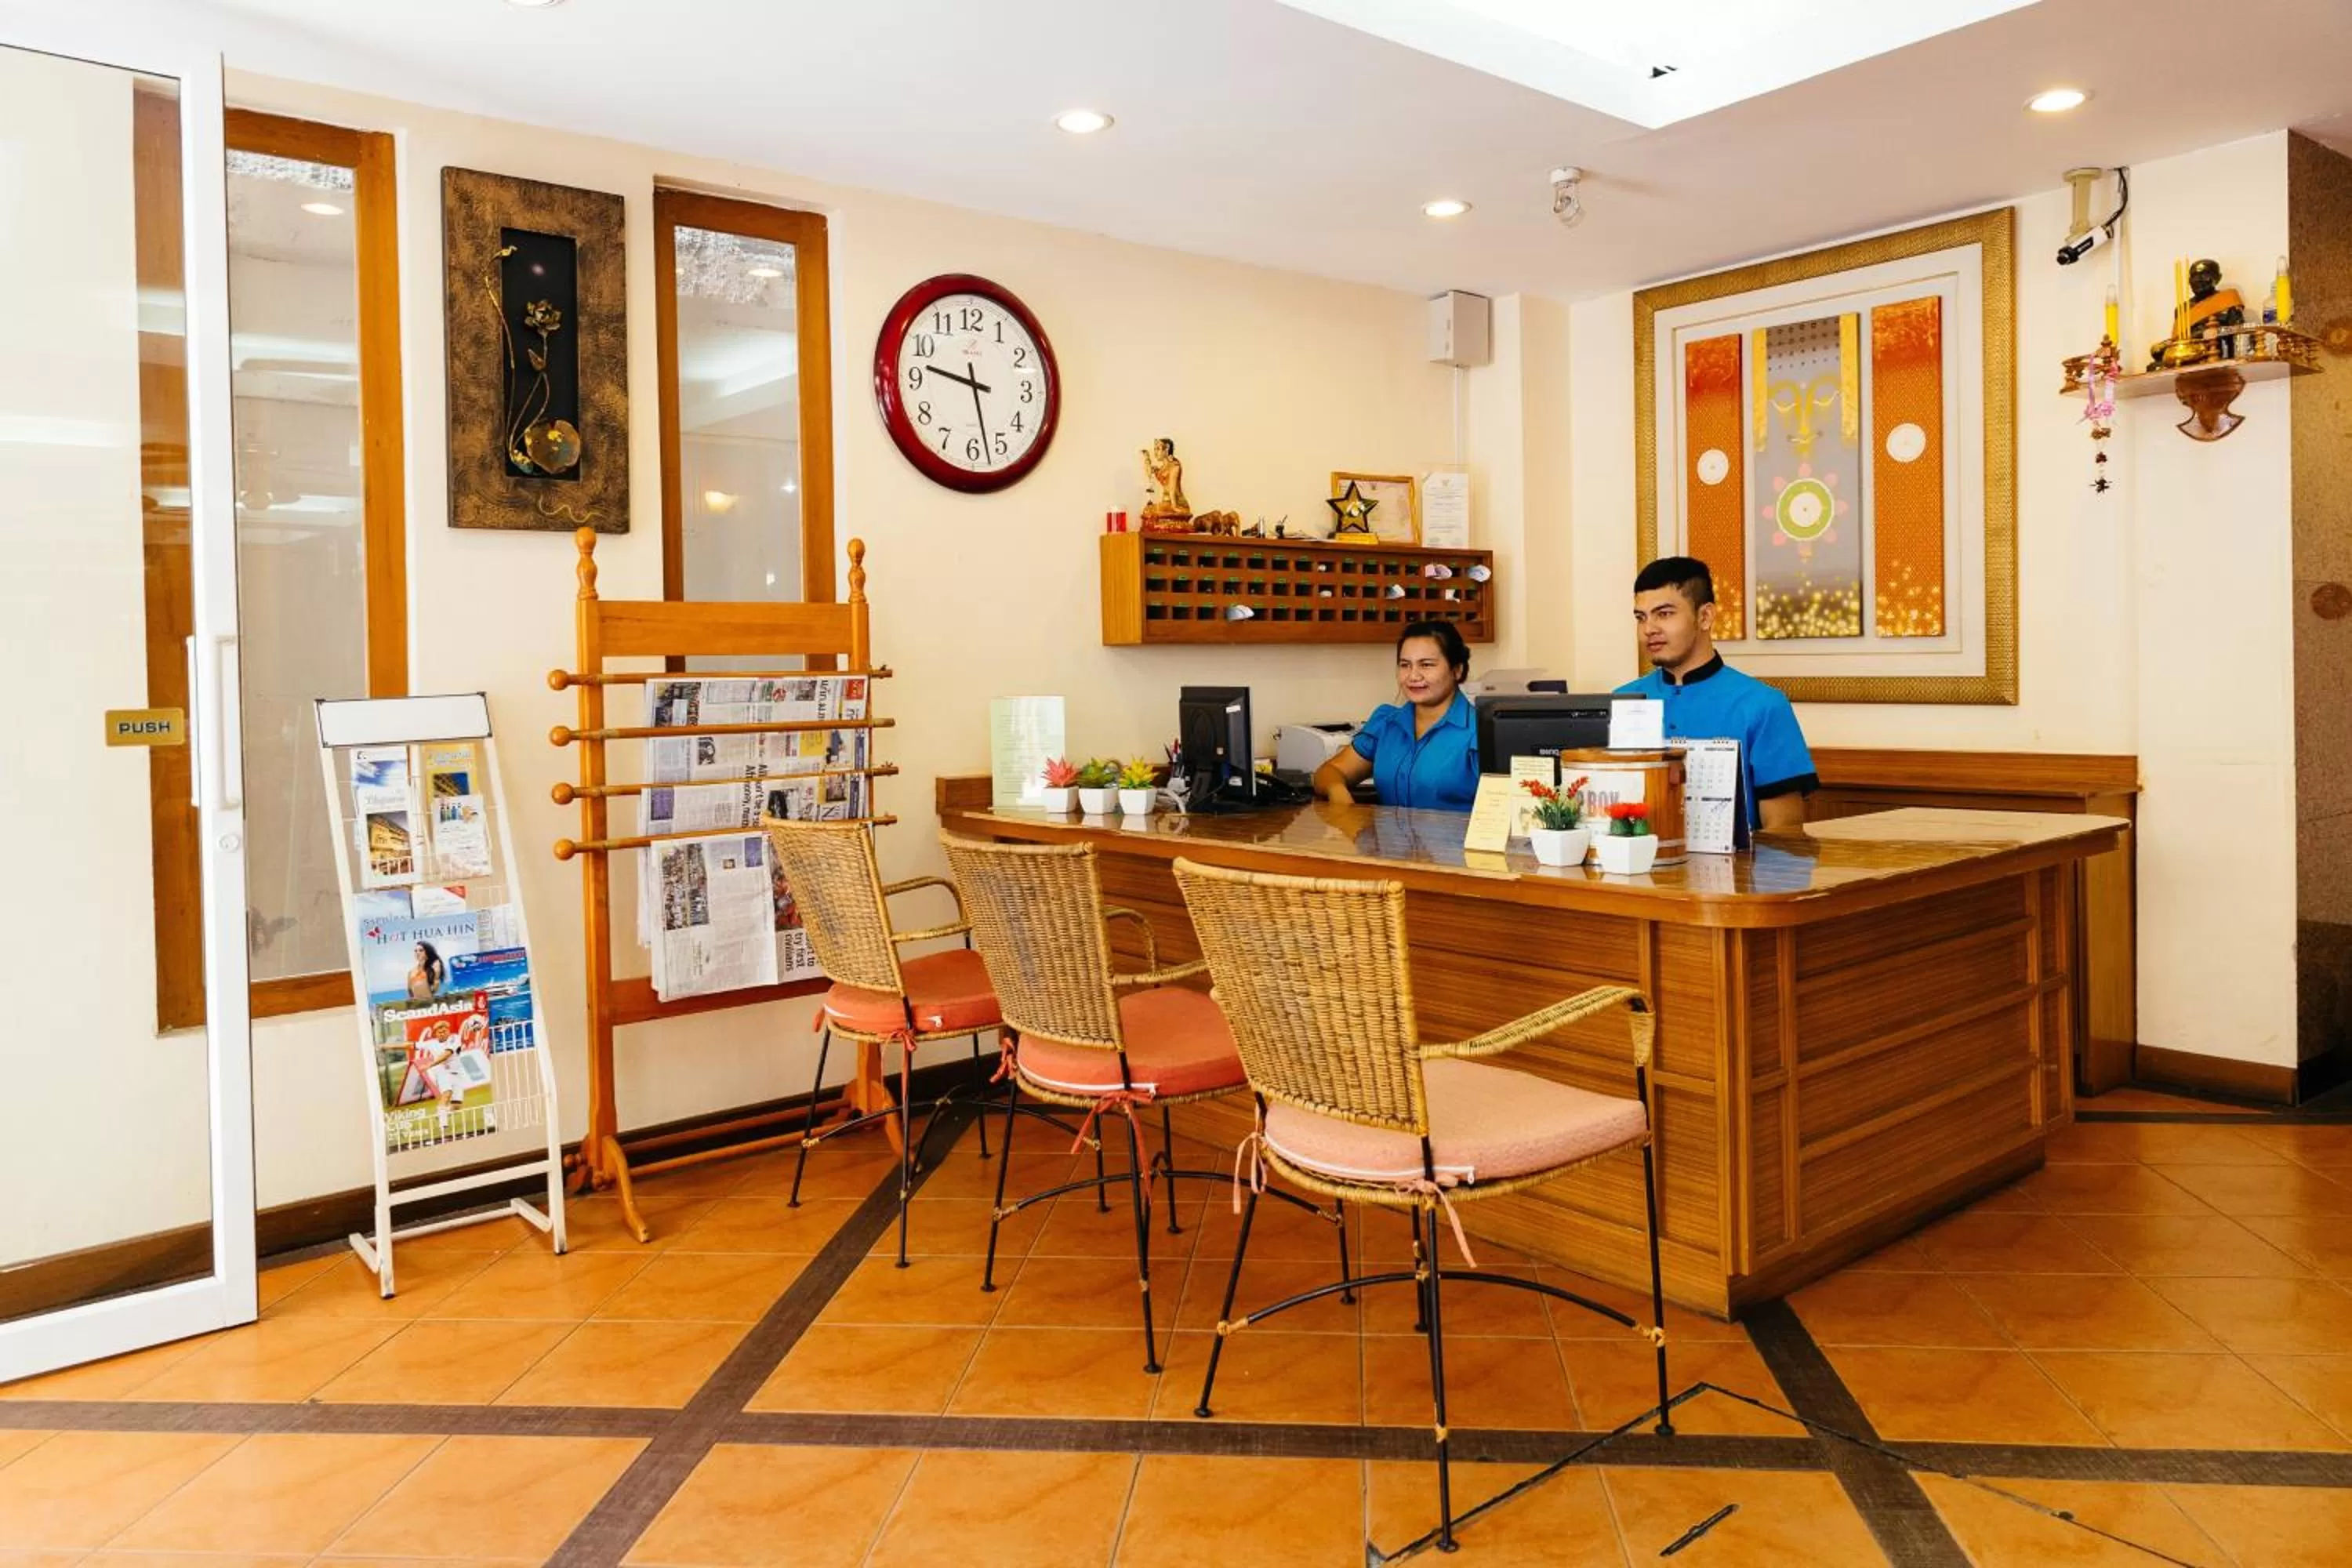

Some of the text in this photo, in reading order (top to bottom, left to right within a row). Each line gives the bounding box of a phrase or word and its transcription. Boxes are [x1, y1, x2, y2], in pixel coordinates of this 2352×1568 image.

[932, 311, 953, 336] 11
[959, 308, 983, 332] 12
[993, 321, 1004, 343] 1
[912, 333, 935, 358] 10
[1014, 347, 1026, 368] 2
[909, 366, 922, 390] 9
[1020, 380, 1033, 403] 3
[917, 401, 931, 425] 8
[1011, 410, 1024, 433] 4
[938, 426, 951, 450] 7
[966, 438, 979, 461] 6
[994, 432, 1007, 455] 5
[118, 720, 170, 735] PUSH
[413, 927, 445, 940] HUA
[448, 923, 475, 936] HIN
